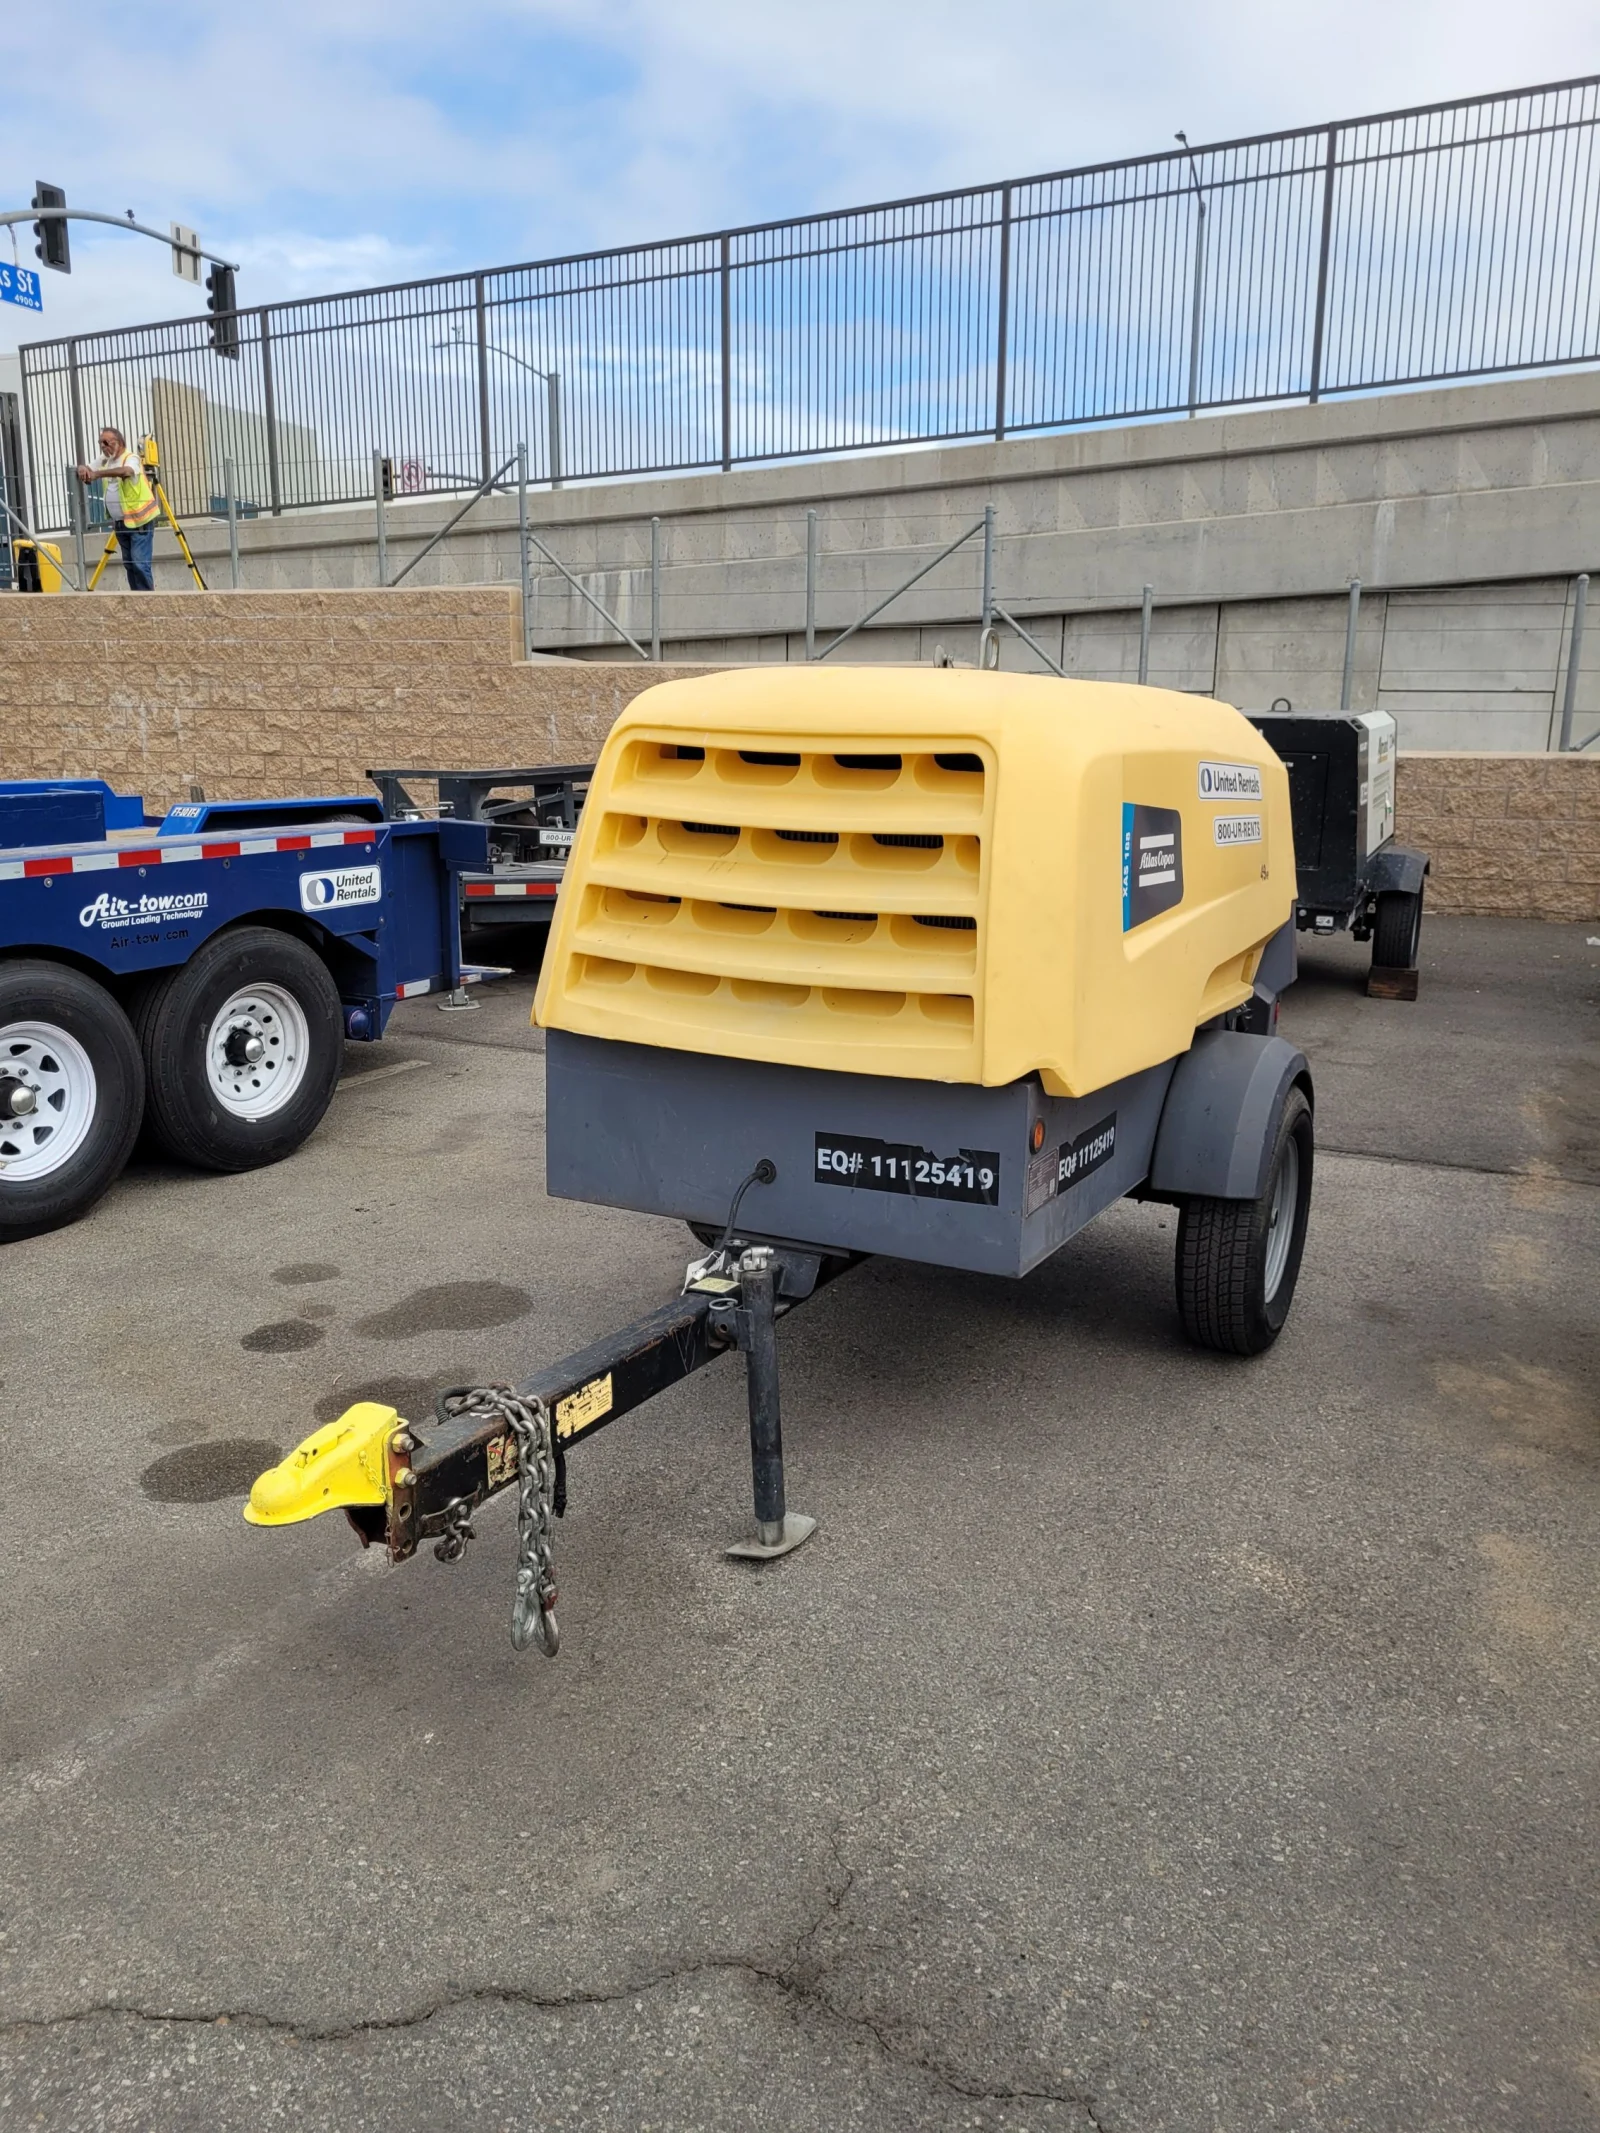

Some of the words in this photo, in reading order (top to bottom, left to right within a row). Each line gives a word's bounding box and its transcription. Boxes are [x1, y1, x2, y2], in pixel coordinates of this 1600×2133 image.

[16, 269, 34, 295] St
[14, 294, 33, 306] 4900
[1213, 770, 1237, 792] United
[1237, 772, 1260, 794] Rentals
[1217, 821, 1260, 840] 800-UR-RENTS
[1139, 853, 1158, 869] Atlas
[1157, 850, 1175, 869] Copco
[336, 872, 373, 888] United
[336, 885, 377, 901] Rentals
[79, 892, 208, 928] Air-tow.com
[101, 917, 130, 929] Ground
[131, 914, 161, 926] Loading
[162, 909, 203, 921] Technology
[1059, 1151, 1078, 1181] EQ#
[1079, 1126, 1115, 1168] 11125419
[817, 1148, 863, 1175] EQ#
[871, 1155, 994, 1190] 11125419
